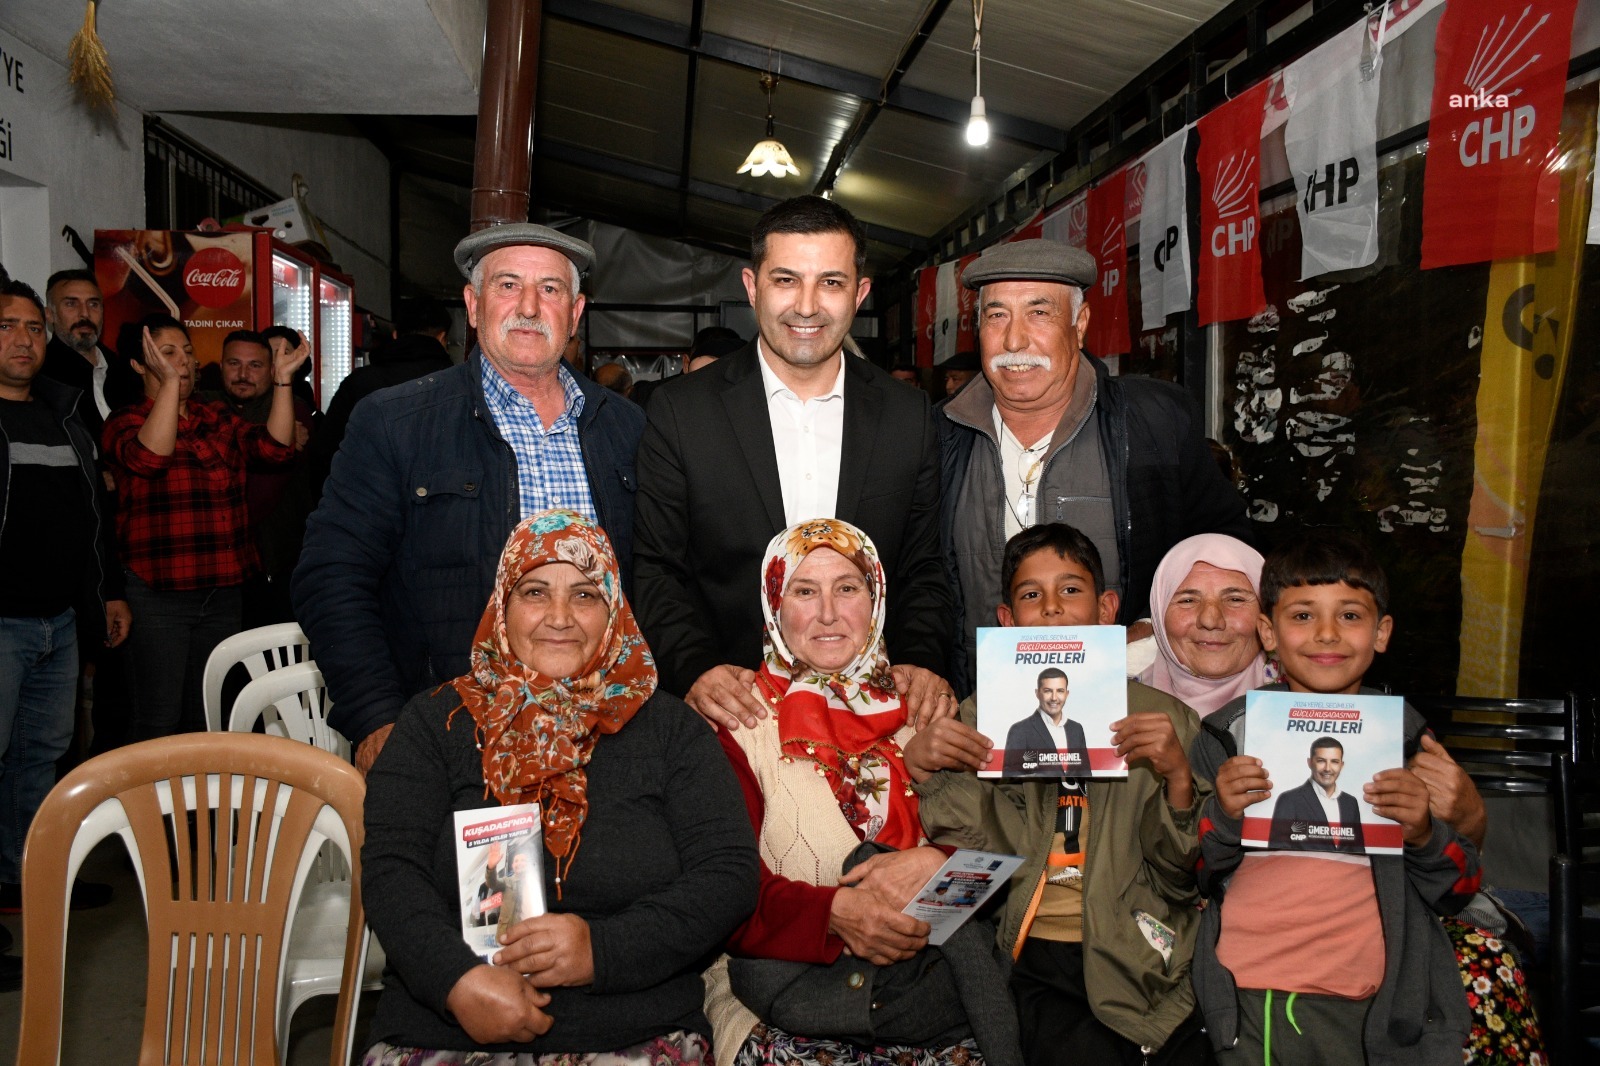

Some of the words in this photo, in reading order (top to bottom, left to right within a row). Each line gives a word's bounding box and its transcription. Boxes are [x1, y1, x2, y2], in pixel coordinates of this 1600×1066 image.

[0, 46, 24, 94] YE
[1459, 104, 1536, 168] CHP
[1211, 216, 1255, 258] CHP
[186, 268, 242, 287] Coca-Cola
[184, 320, 214, 328] TADINI
[216, 320, 244, 329] ÇIKAR
[1015, 649, 1085, 664] PROJELERİ
[1292, 710, 1314, 718] GÜÇLÜ
[1286, 719, 1363, 734] PROJELERİ
[1039, 753, 1058, 761] ÖMER
[1059, 753, 1081, 761] GÜNEL
[464, 815, 533, 837] KUŞADASI'NDA
[1308, 825, 1329, 835] ÖMER
[1330, 826, 1354, 836] GÜNEL
[473, 837, 490, 845] YILDA
